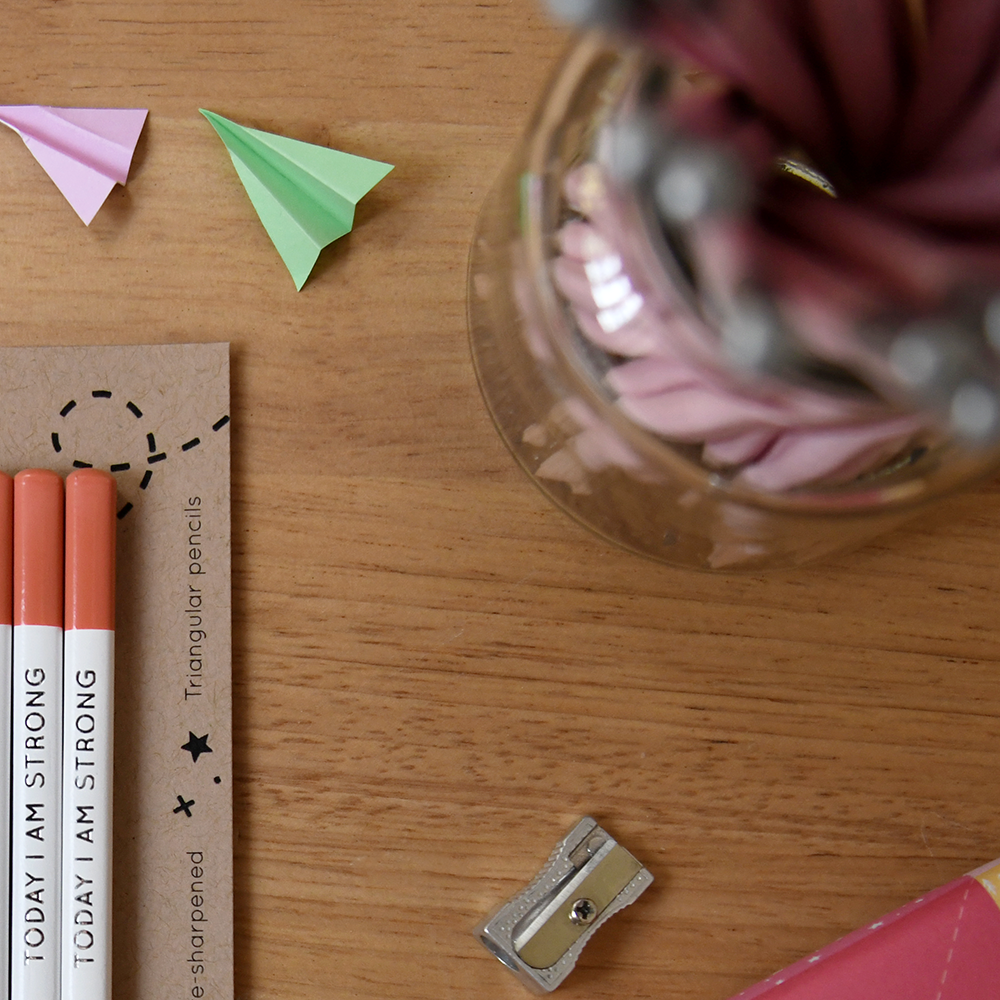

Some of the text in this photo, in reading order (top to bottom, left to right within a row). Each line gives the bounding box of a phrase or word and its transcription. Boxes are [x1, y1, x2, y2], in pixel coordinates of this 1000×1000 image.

[184, 496, 207, 701] Triangular pencils
[24, 667, 46, 788] STRONG
[75, 669, 97, 790] STRONG
[25, 803, 45, 841] AM
[76, 805, 95, 844] AM
[24, 871, 45, 966] TODAY
[73, 874, 95, 968] TODAY
